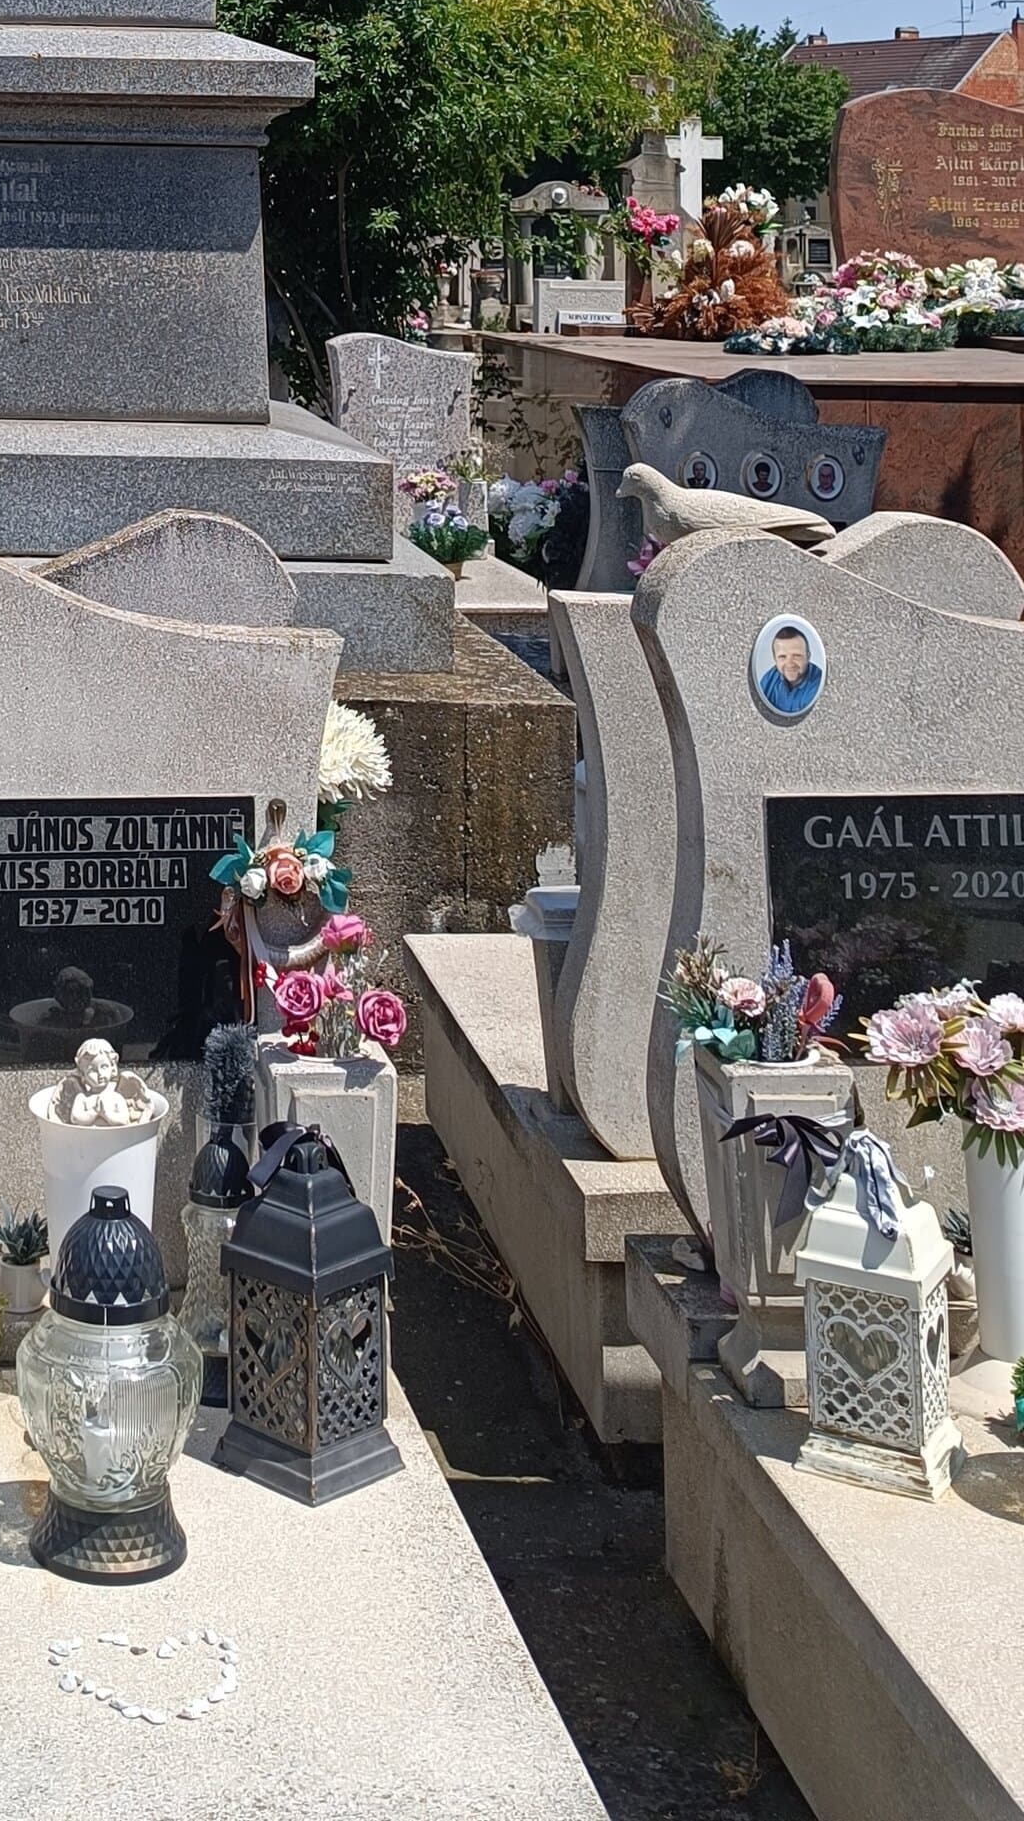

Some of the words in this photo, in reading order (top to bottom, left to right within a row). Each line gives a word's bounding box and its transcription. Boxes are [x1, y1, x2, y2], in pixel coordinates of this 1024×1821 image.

[979, 156, 1024, 172] Károl
[8, 811, 93, 852] JÁNOS
[105, 809, 244, 851] ZOLTÁNNÉ
[804, 806, 913, 849] GAÁL
[924, 814, 1024, 847] ATTIL
[64, 852, 186, 890] BORBÁLA
[840, 872, 916, 900] 1975
[951, 871, 1024, 898] 2020
